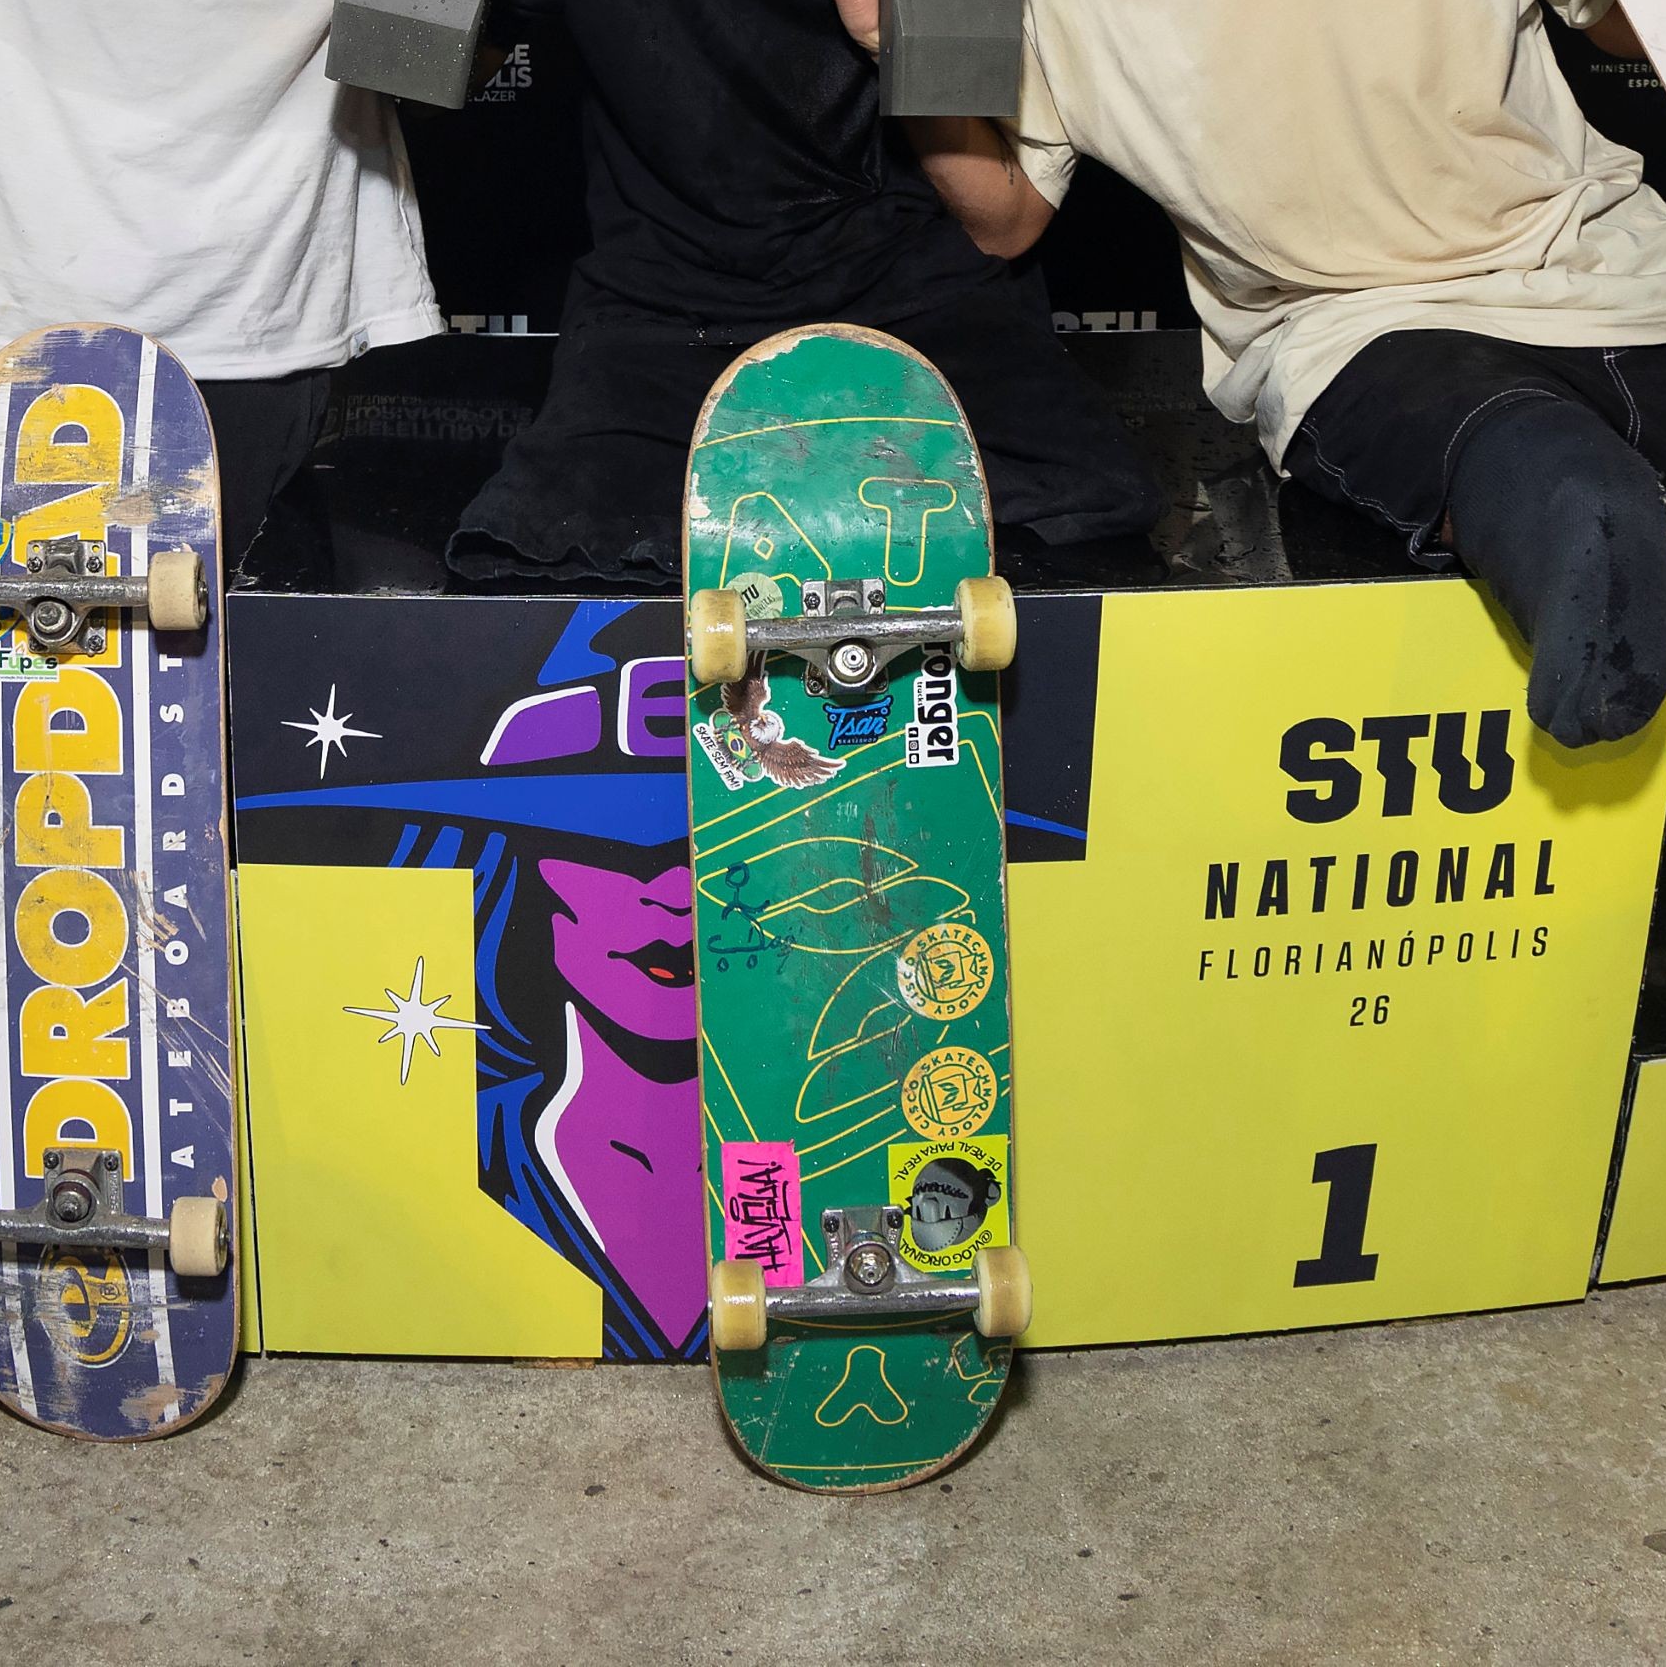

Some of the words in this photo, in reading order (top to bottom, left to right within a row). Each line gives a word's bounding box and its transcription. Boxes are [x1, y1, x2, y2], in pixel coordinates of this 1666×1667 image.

[696, 725, 717, 754] SKATE
[713, 749, 730, 771] SEM
[1278, 709, 1515, 824] STU
[1202, 838, 1556, 921] NATIONAL
[1199, 925, 1550, 982] FLORIANÓPOLIS
[904, 956, 927, 1008] CISCO
[1349, 994, 1390, 1028] 26
[907, 1079, 930, 1130] CISCO
[894, 1152, 923, 1182] REAL
[920, 1140, 955, 1157] PARA
[958, 1141, 987, 1161] REAL
[985, 1155, 1003, 1173] DE
[1292, 1143, 1379, 1288] 1
[899, 1238, 952, 1266] ORIGINAL
[953, 1230, 993, 1264] @VLOG
